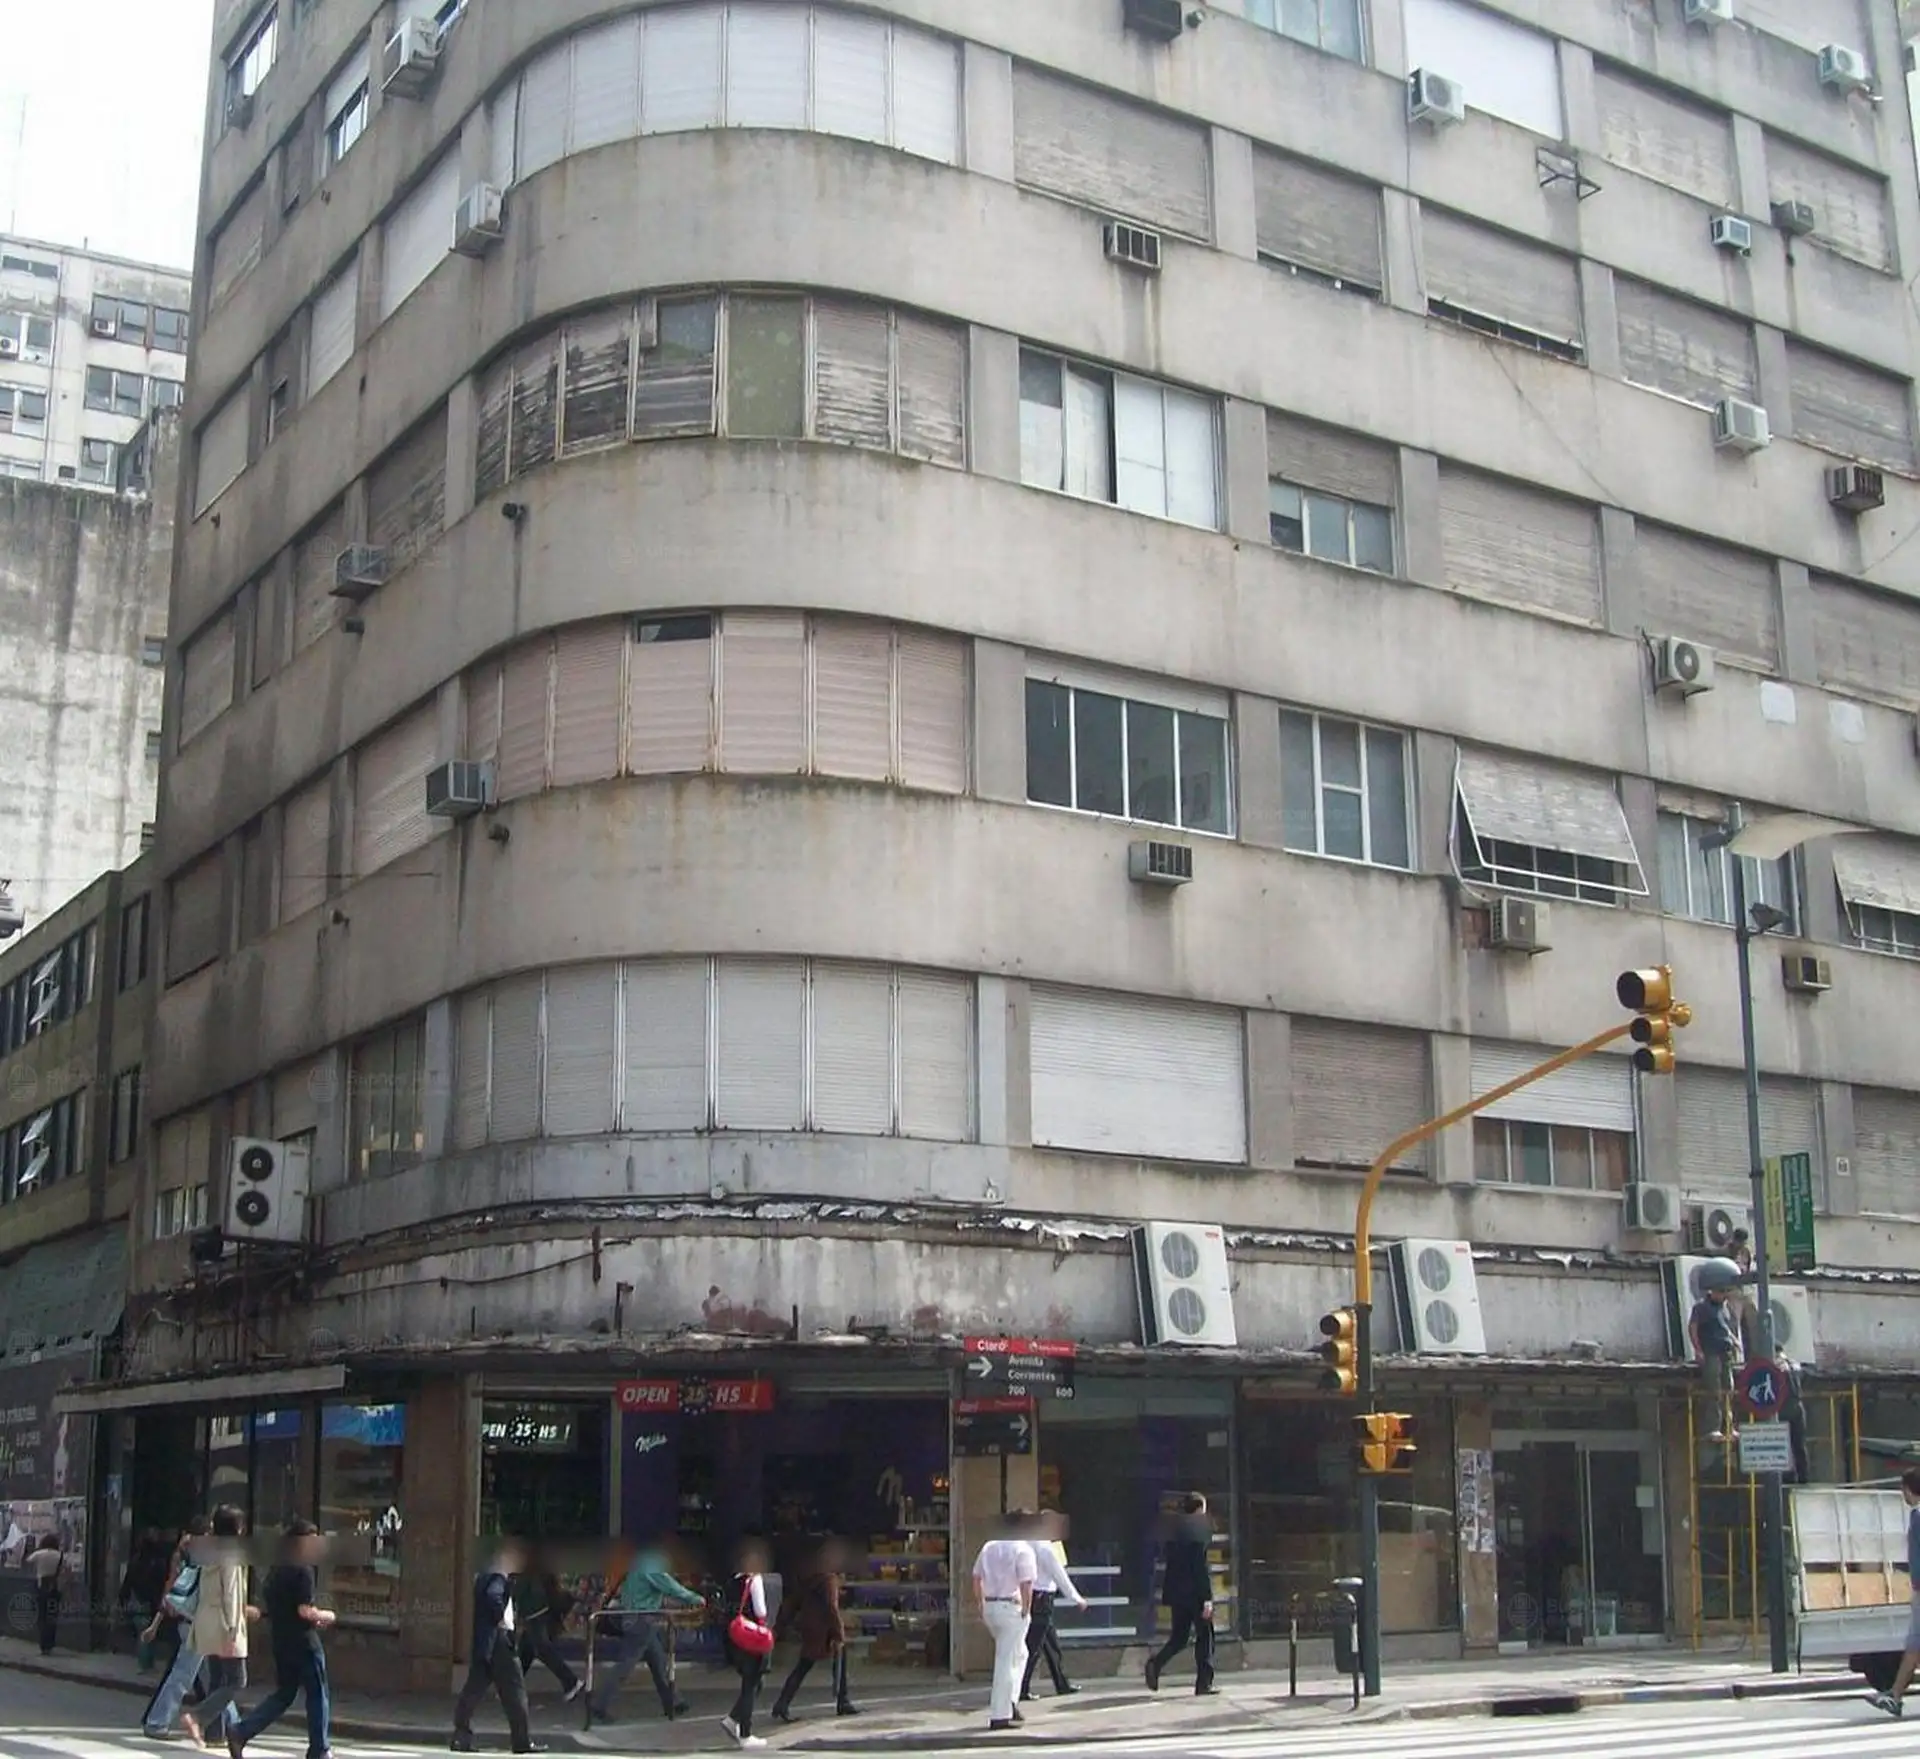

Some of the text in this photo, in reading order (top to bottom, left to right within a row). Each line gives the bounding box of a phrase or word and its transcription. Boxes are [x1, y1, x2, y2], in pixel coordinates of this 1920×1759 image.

[1008, 1354, 1044, 1367] Avenida
[1007, 1369, 1056, 1382] Corrientes
[622, 1385, 670, 1404] OPEN
[716, 1384, 741, 1404] HS
[538, 1423, 559, 1440] HS
